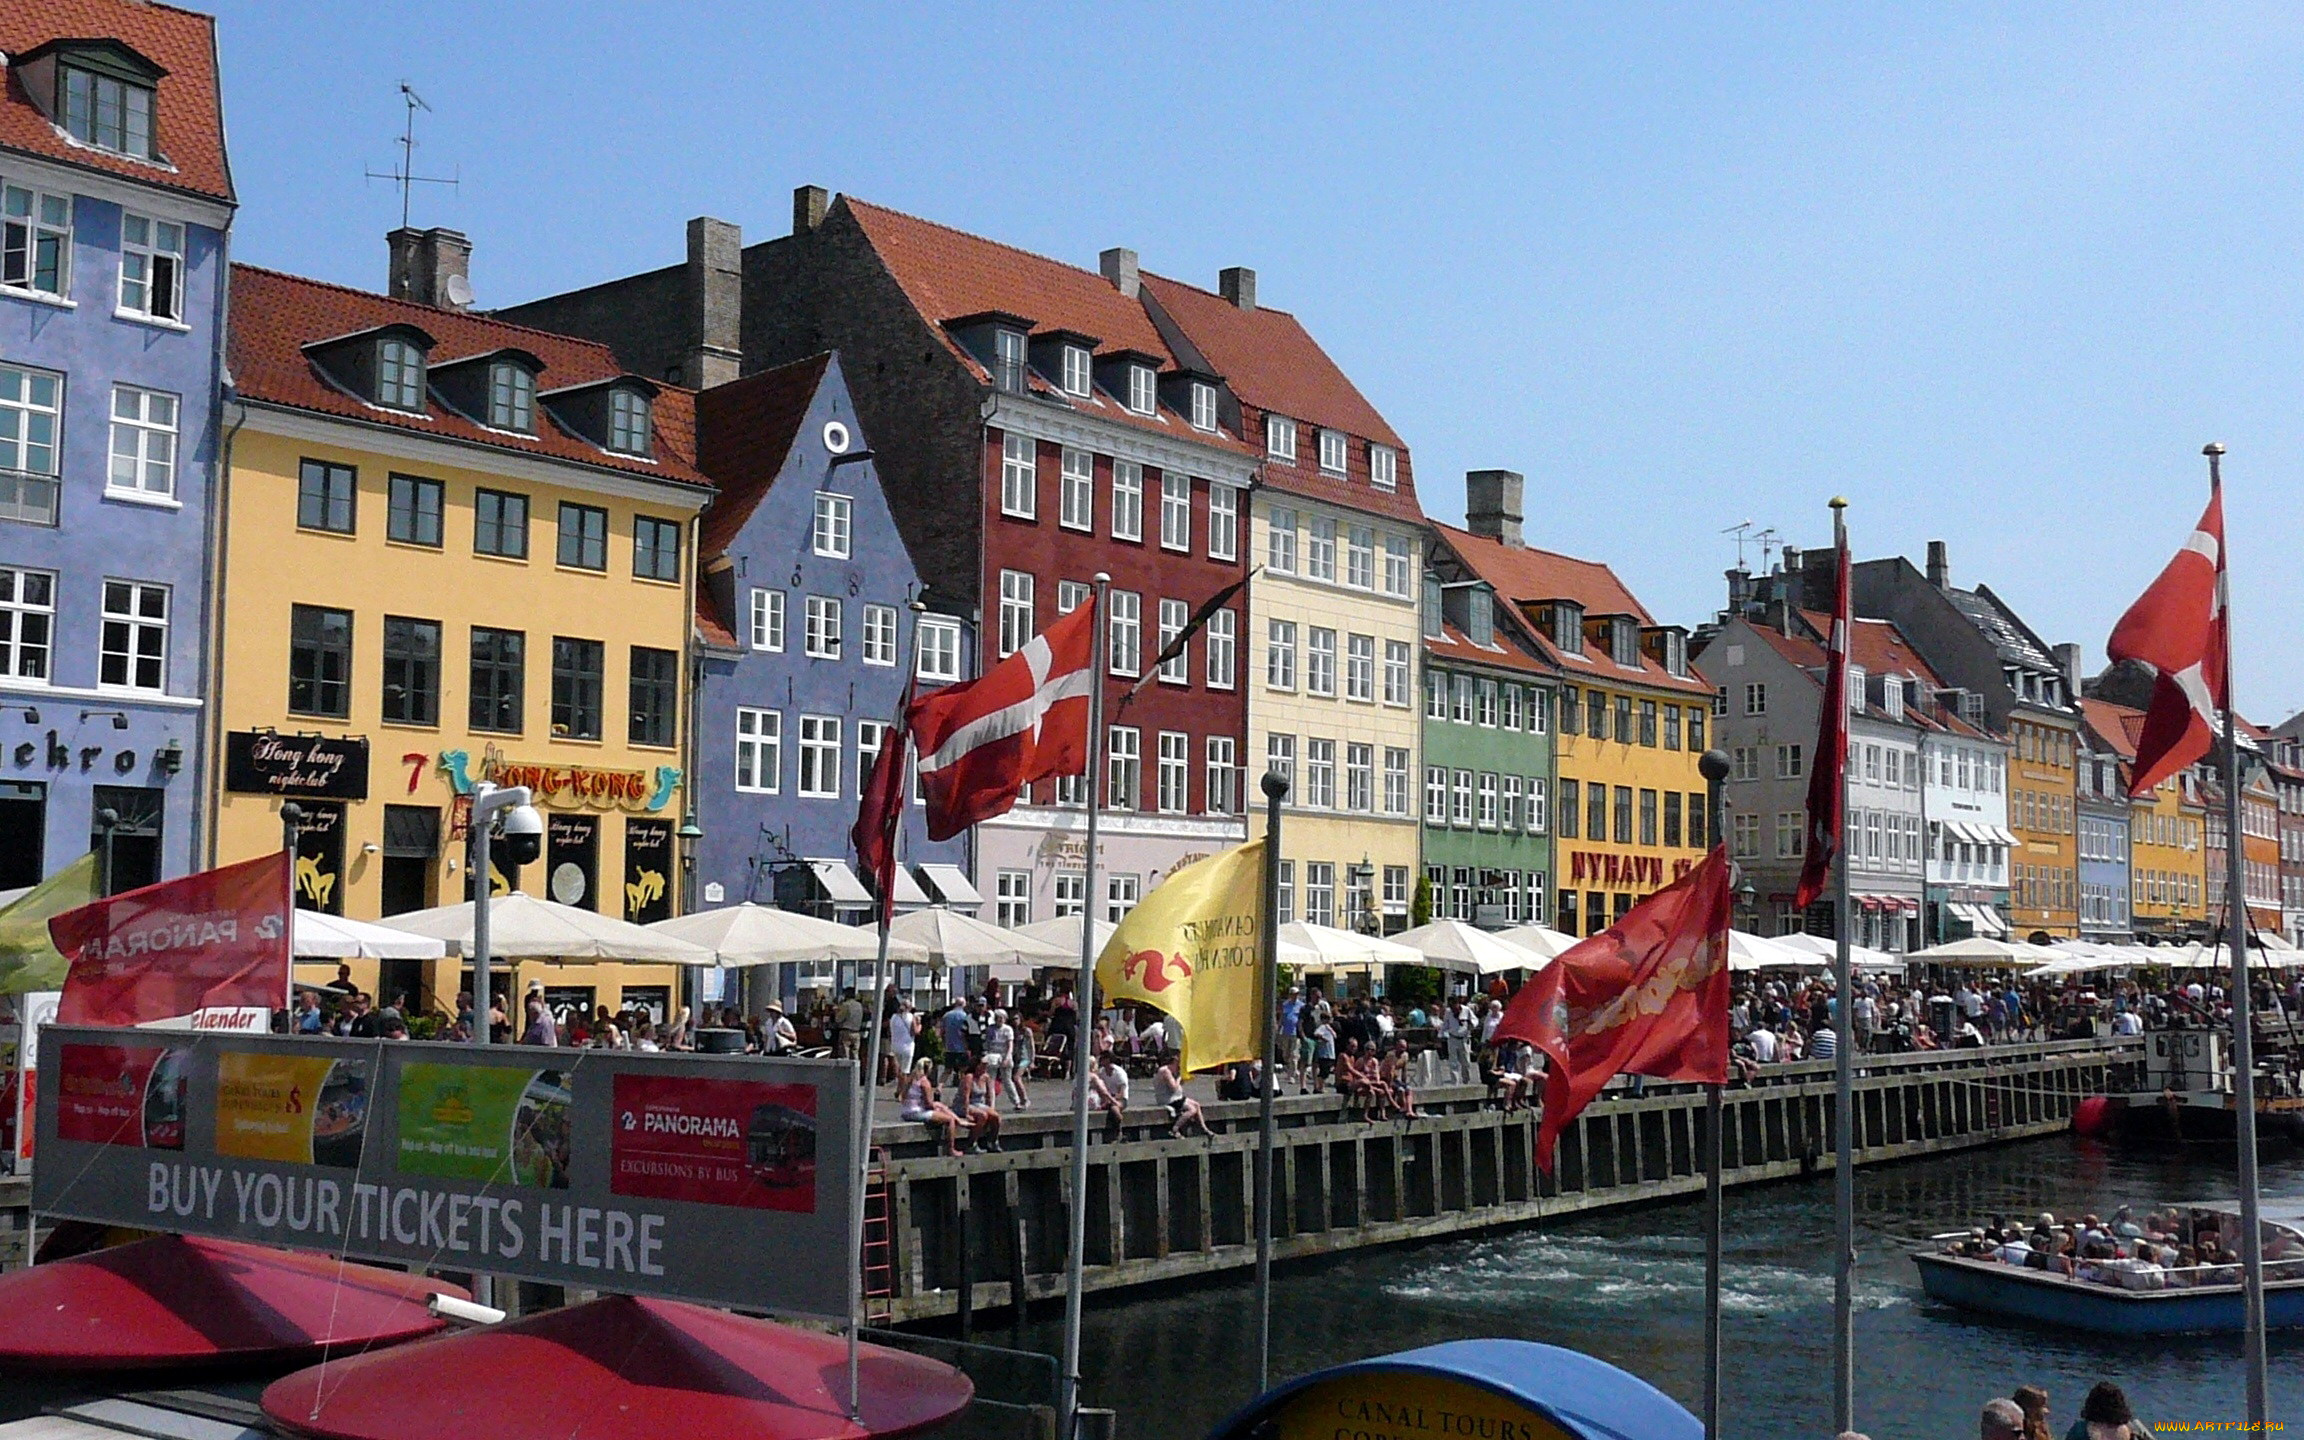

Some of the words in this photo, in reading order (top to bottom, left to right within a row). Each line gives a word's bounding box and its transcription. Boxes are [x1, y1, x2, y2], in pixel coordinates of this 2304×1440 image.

[253, 736, 303, 771] Hong
[306, 744, 345, 773] kong
[268, 769, 331, 791] nightclub
[402, 752, 428, 795] 7
[1571, 852, 1663, 884] NYHAVN
[644, 1112, 740, 1138] PANORAMA
[621, 1159, 693, 1179] EXCURSIONS
[698, 1167, 711, 1180] BY
[716, 1168, 738, 1182] BUS
[149, 1162, 222, 1219] BUY
[232, 1170, 340, 1235] YOUR
[353, 1183, 524, 1258] TICKETS
[540, 1203, 665, 1276] HERE
[1338, 1399, 1430, 1430] CANAL
[1439, 1411, 1532, 1440] TOURS
